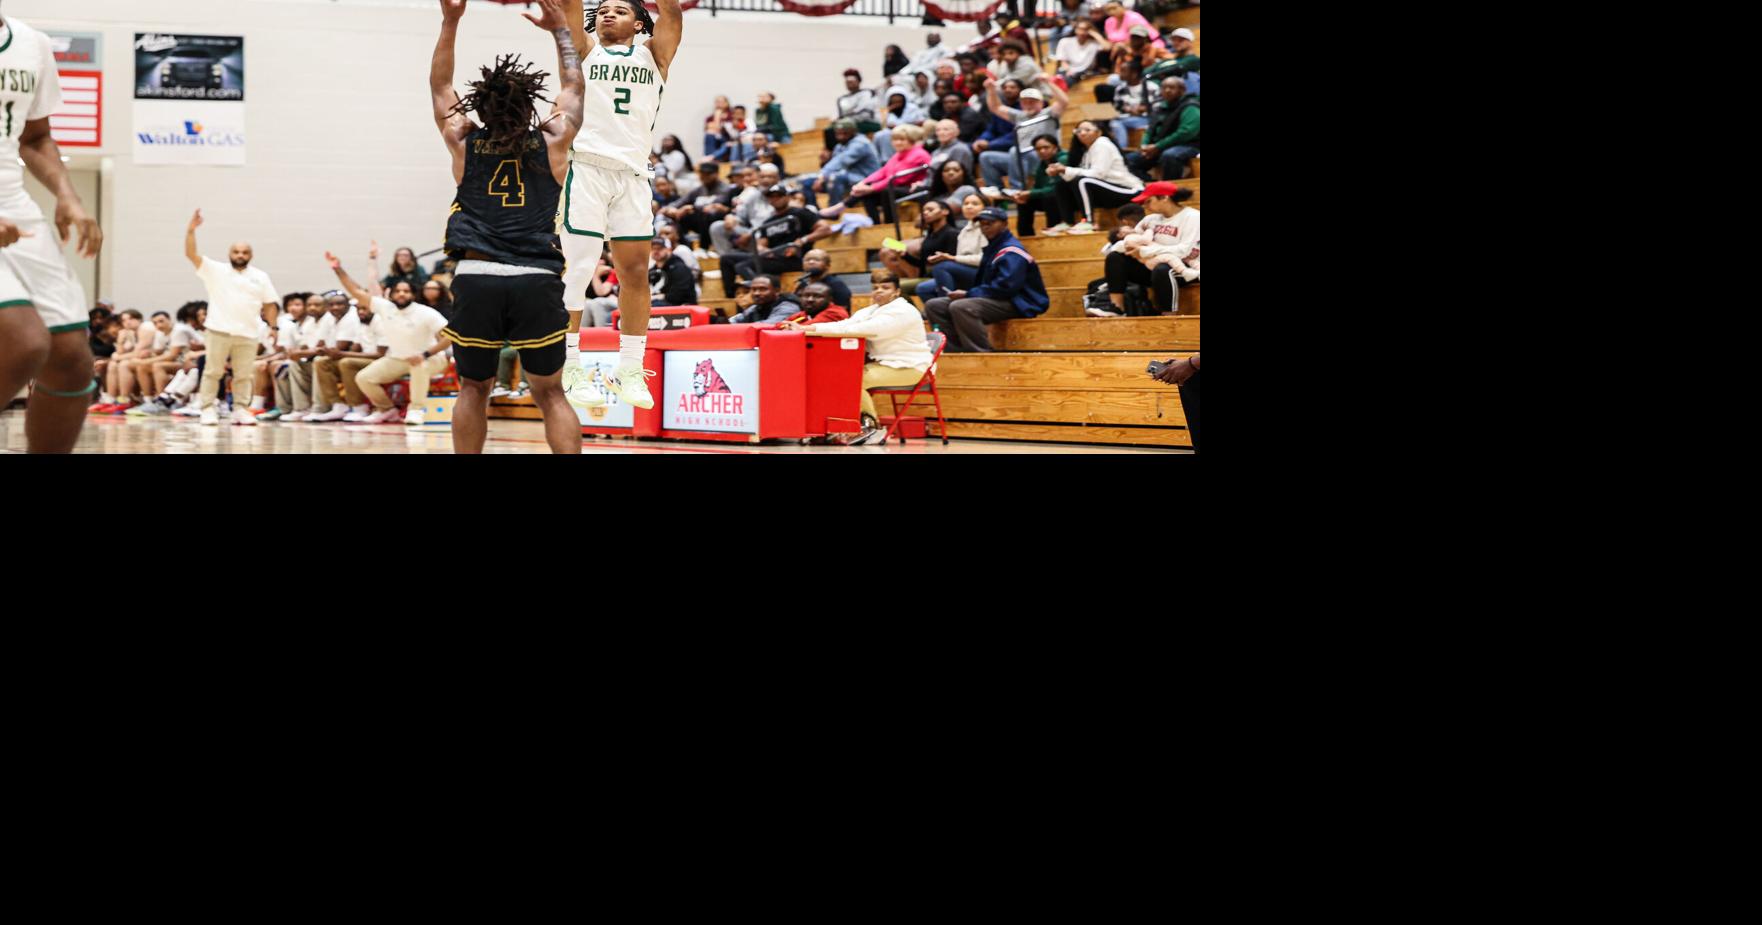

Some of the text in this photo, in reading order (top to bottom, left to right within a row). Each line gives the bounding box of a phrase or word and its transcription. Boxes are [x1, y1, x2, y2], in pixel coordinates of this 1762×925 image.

[589, 64, 654, 86] GRAYSON
[613, 87, 631, 115] 2
[488, 159, 525, 207] 4
[677, 393, 744, 415] ARCHER
